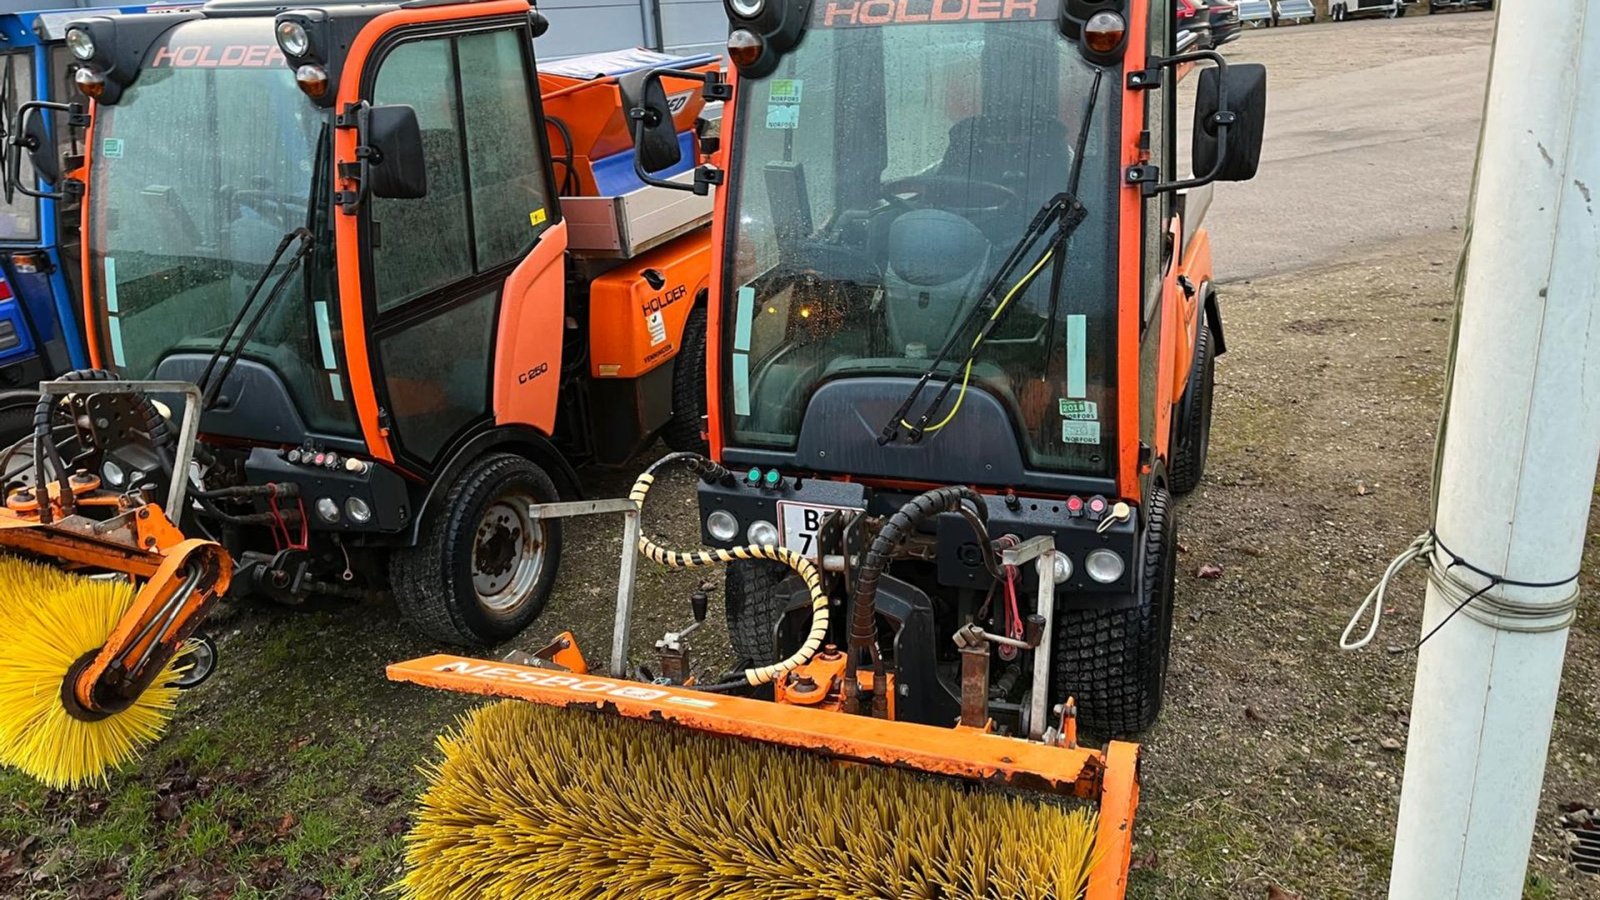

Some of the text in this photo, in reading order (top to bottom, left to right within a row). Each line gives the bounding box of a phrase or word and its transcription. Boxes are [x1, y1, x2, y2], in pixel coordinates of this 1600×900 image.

[824, 0, 1038, 26] HOLDER
[642, 284, 687, 317] HOLDER
[519, 362, 548, 384] C 250
[1061, 403, 1085, 412] 2018
